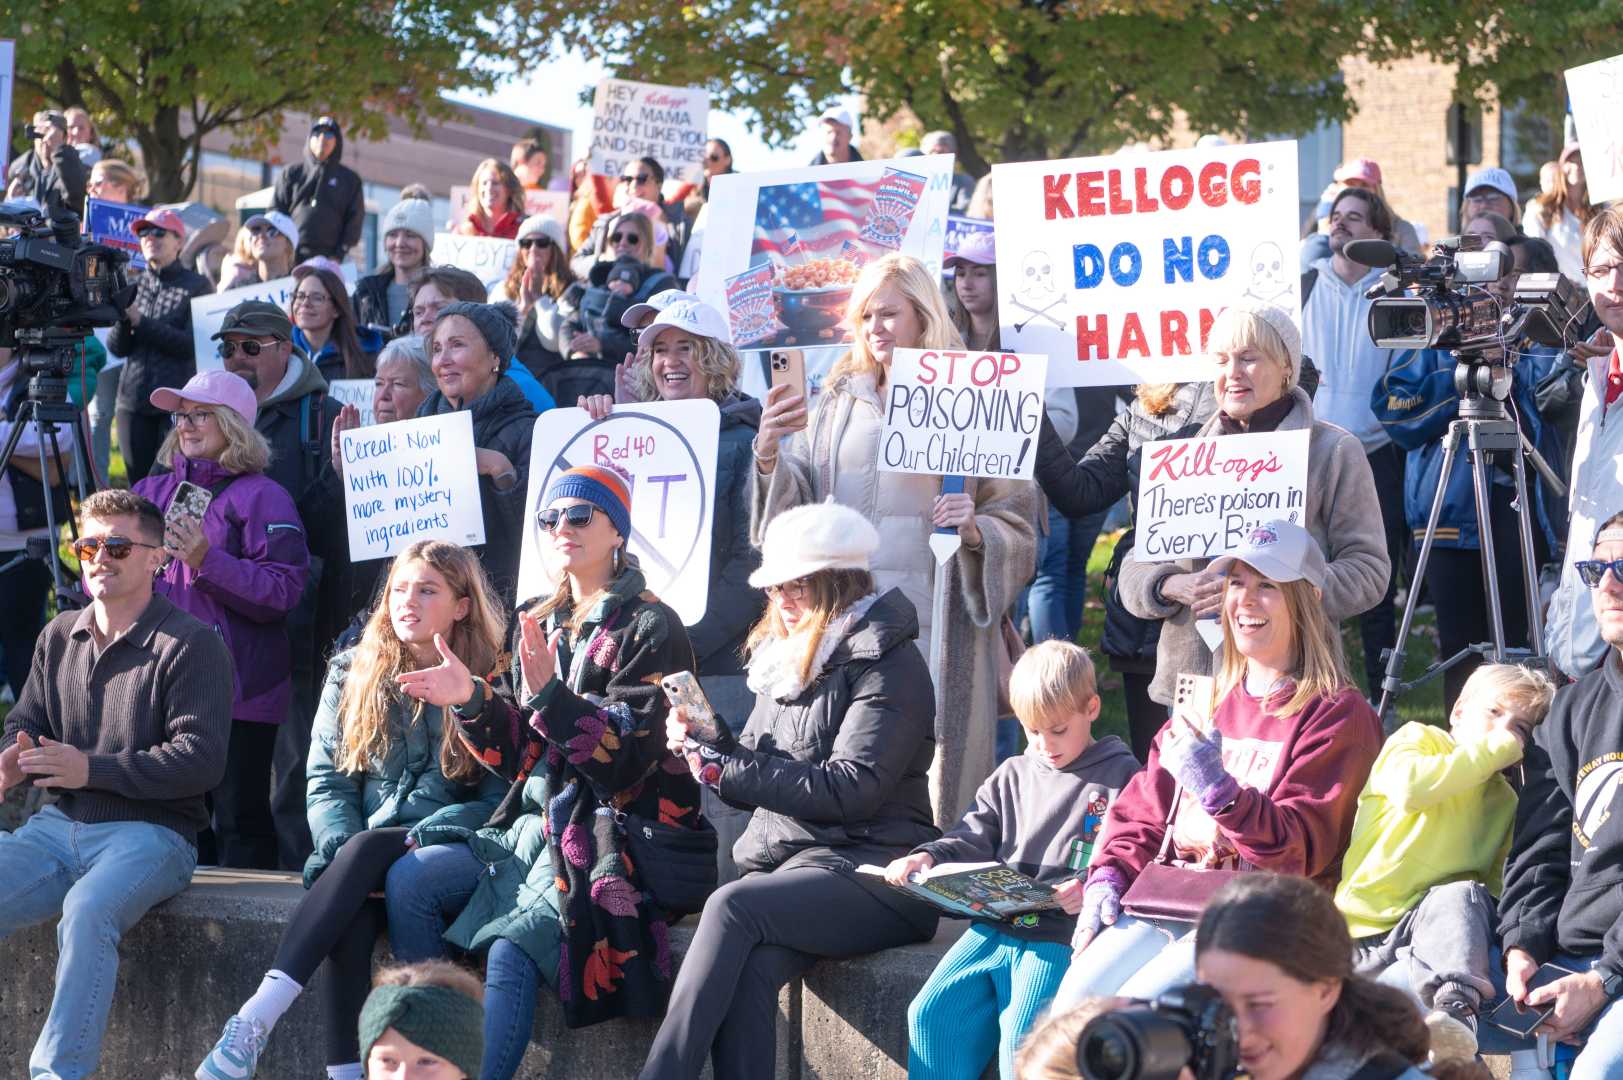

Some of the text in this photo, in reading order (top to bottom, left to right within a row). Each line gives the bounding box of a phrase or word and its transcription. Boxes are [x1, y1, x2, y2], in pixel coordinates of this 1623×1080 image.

[607, 84, 638, 101] HEY
[593, 116, 706, 147] DON'T LIKE YOU
[604, 102, 690, 126] MY MAMA
[592, 135, 706, 162] AND SHE LIKES
[1073, 234, 1231, 289] DO NO
[916, 351, 1021, 388] STOP
[887, 384, 1040, 435] POISONING
[343, 428, 441, 464] Cereal: Now
[593, 434, 655, 464] Red 40
[885, 430, 1032, 476] Our Children!
[397, 457, 439, 490] 100%
[352, 487, 452, 520] more mystery
[1143, 483, 1303, 520] There's poison in
[364, 512, 449, 552] ingredients
[1146, 521, 1218, 556] Every
